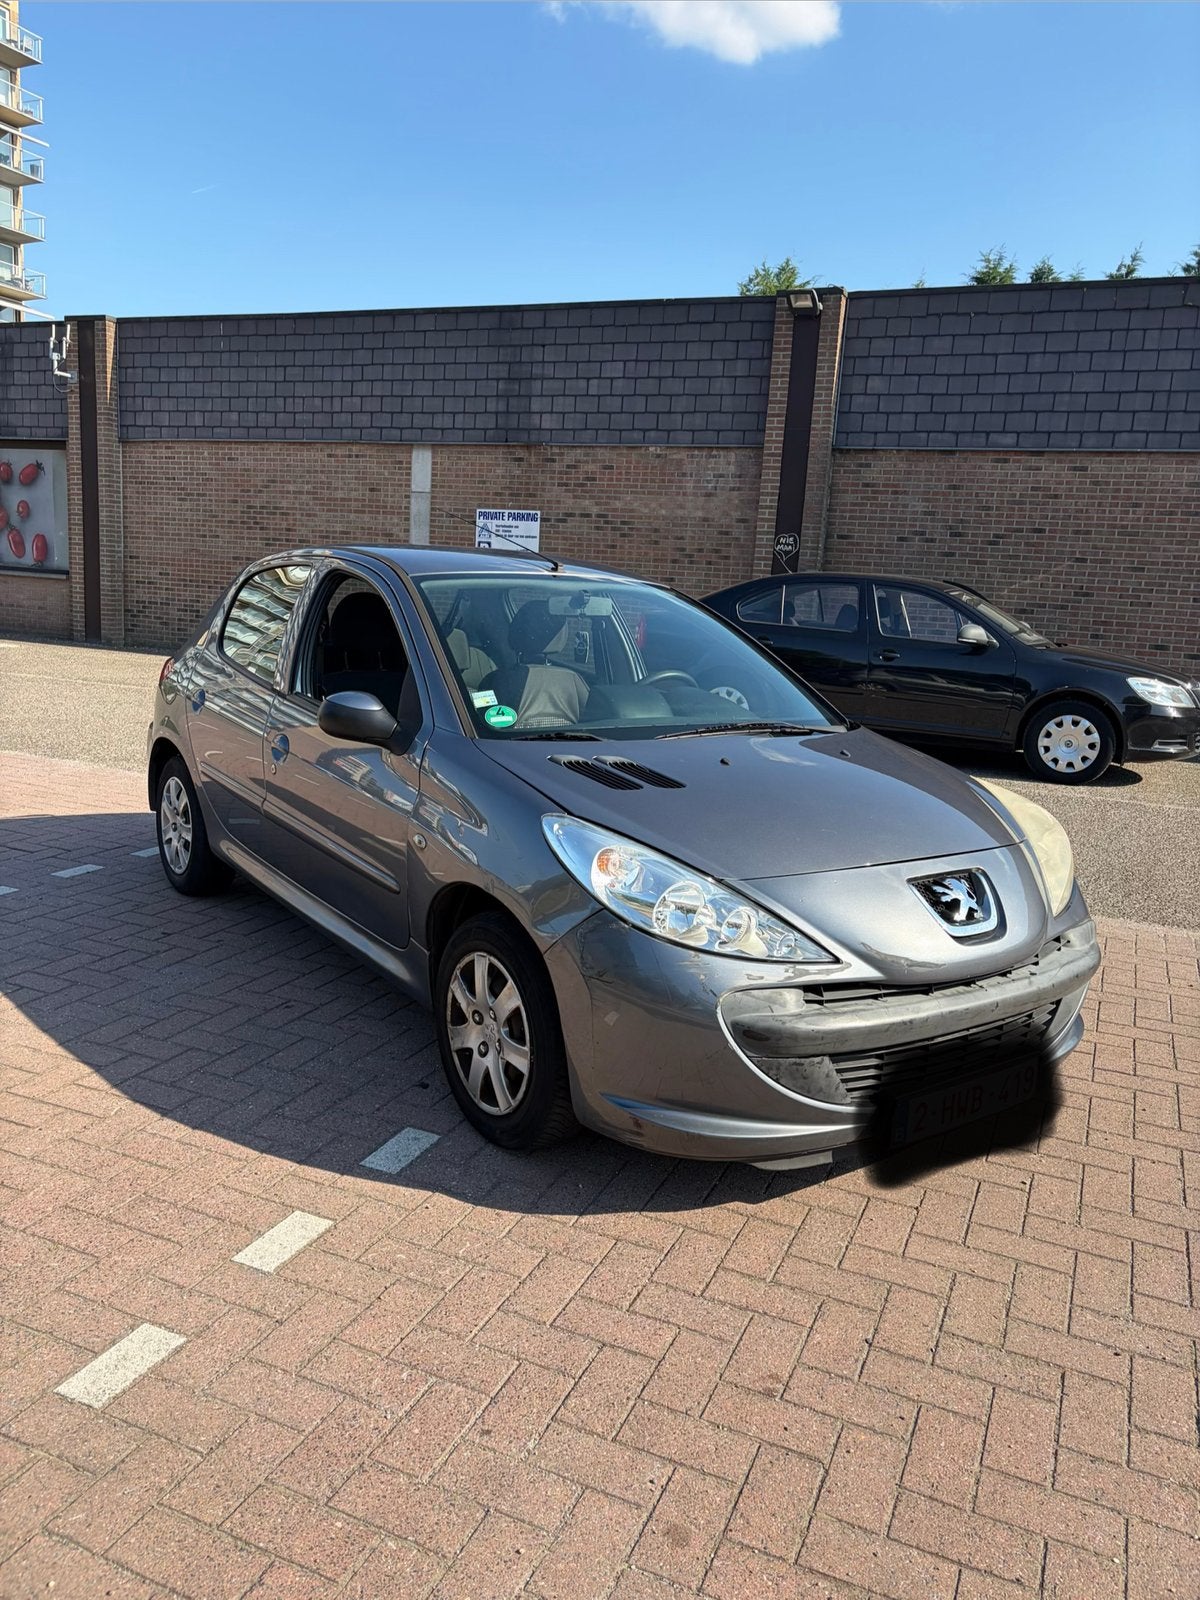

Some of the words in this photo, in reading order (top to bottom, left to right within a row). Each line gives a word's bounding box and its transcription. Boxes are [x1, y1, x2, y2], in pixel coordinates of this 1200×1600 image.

[478, 511, 506, 522] PRIVATE
[507, 512, 539, 523] PARKING
[496, 707, 506, 716] 4
